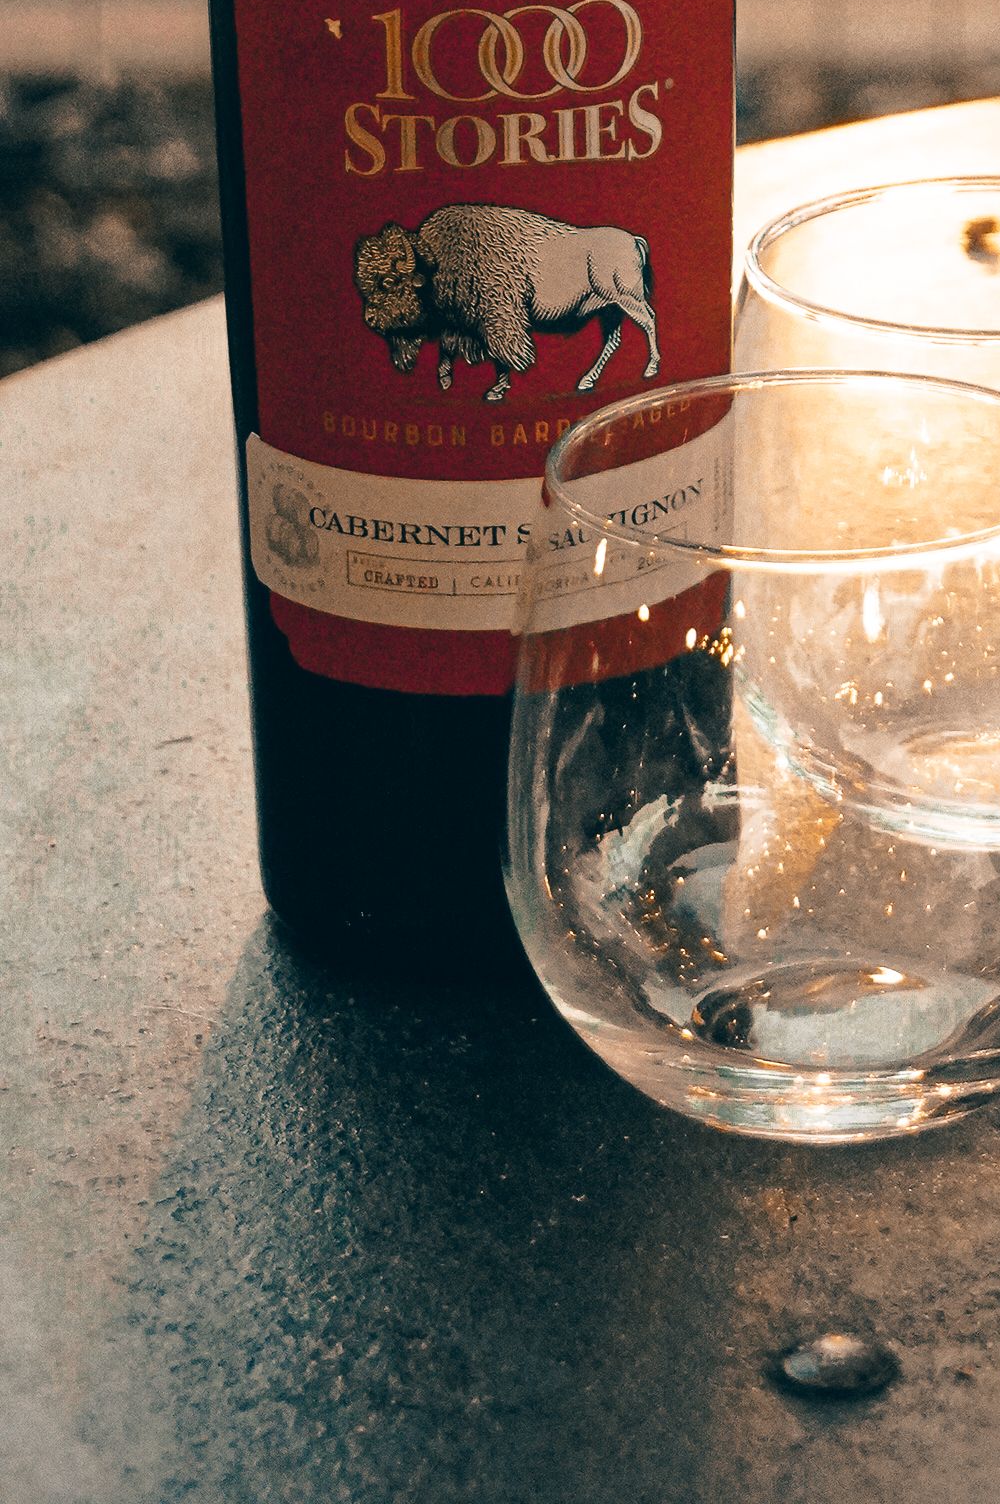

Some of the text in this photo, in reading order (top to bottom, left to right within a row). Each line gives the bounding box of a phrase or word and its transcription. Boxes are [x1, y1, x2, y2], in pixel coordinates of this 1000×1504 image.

[344, 81, 663, 177] STORIES
[323, 410, 467, 446] BOURBON
[309, 506, 507, 547] CABERNET
[363, 570, 439, 589] CRAFTED
